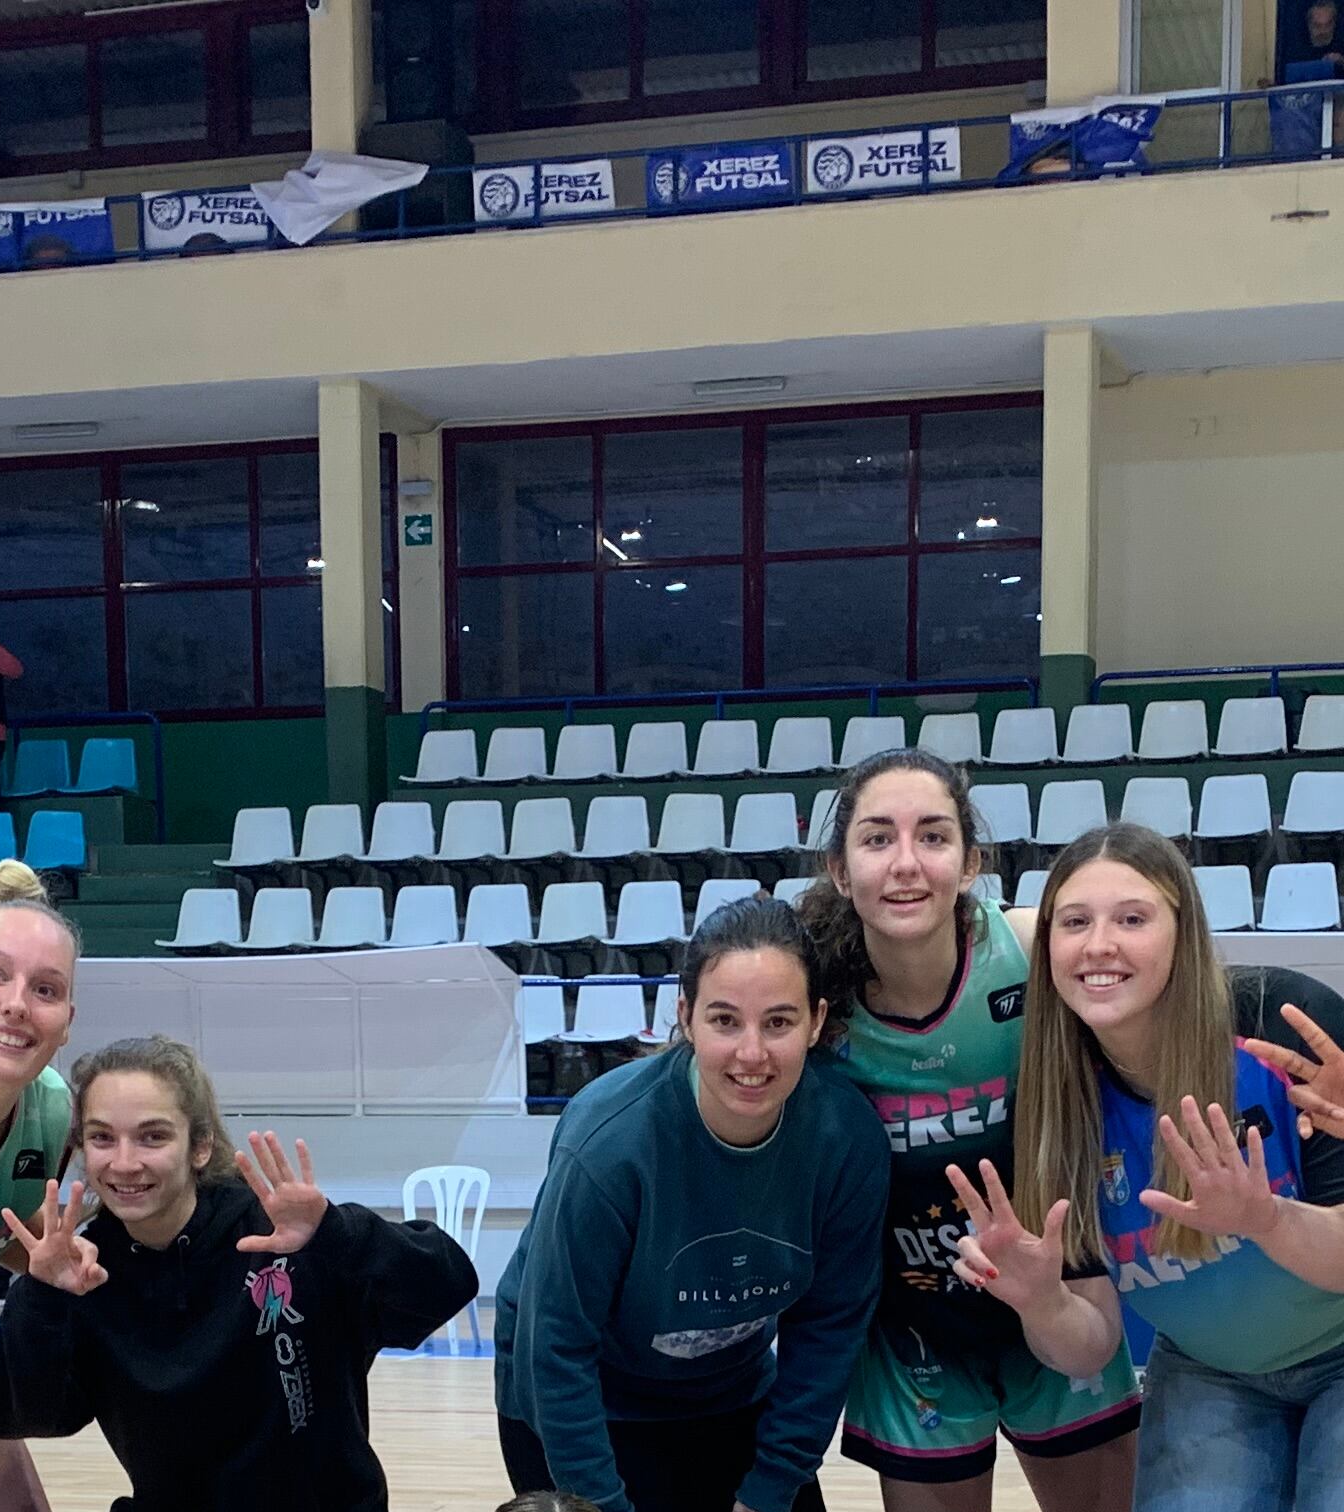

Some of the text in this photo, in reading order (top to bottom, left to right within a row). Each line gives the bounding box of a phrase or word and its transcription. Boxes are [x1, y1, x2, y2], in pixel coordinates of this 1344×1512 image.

[701, 154, 780, 176] XEREZ
[858, 157, 957, 180] FUTSAL
[694, 172, 790, 193] FUTSAL
[188, 210, 269, 226] FUTSAL
[868, 1076, 1008, 1153] EREZ
[678, 1280, 792, 1302] BILLABONG
